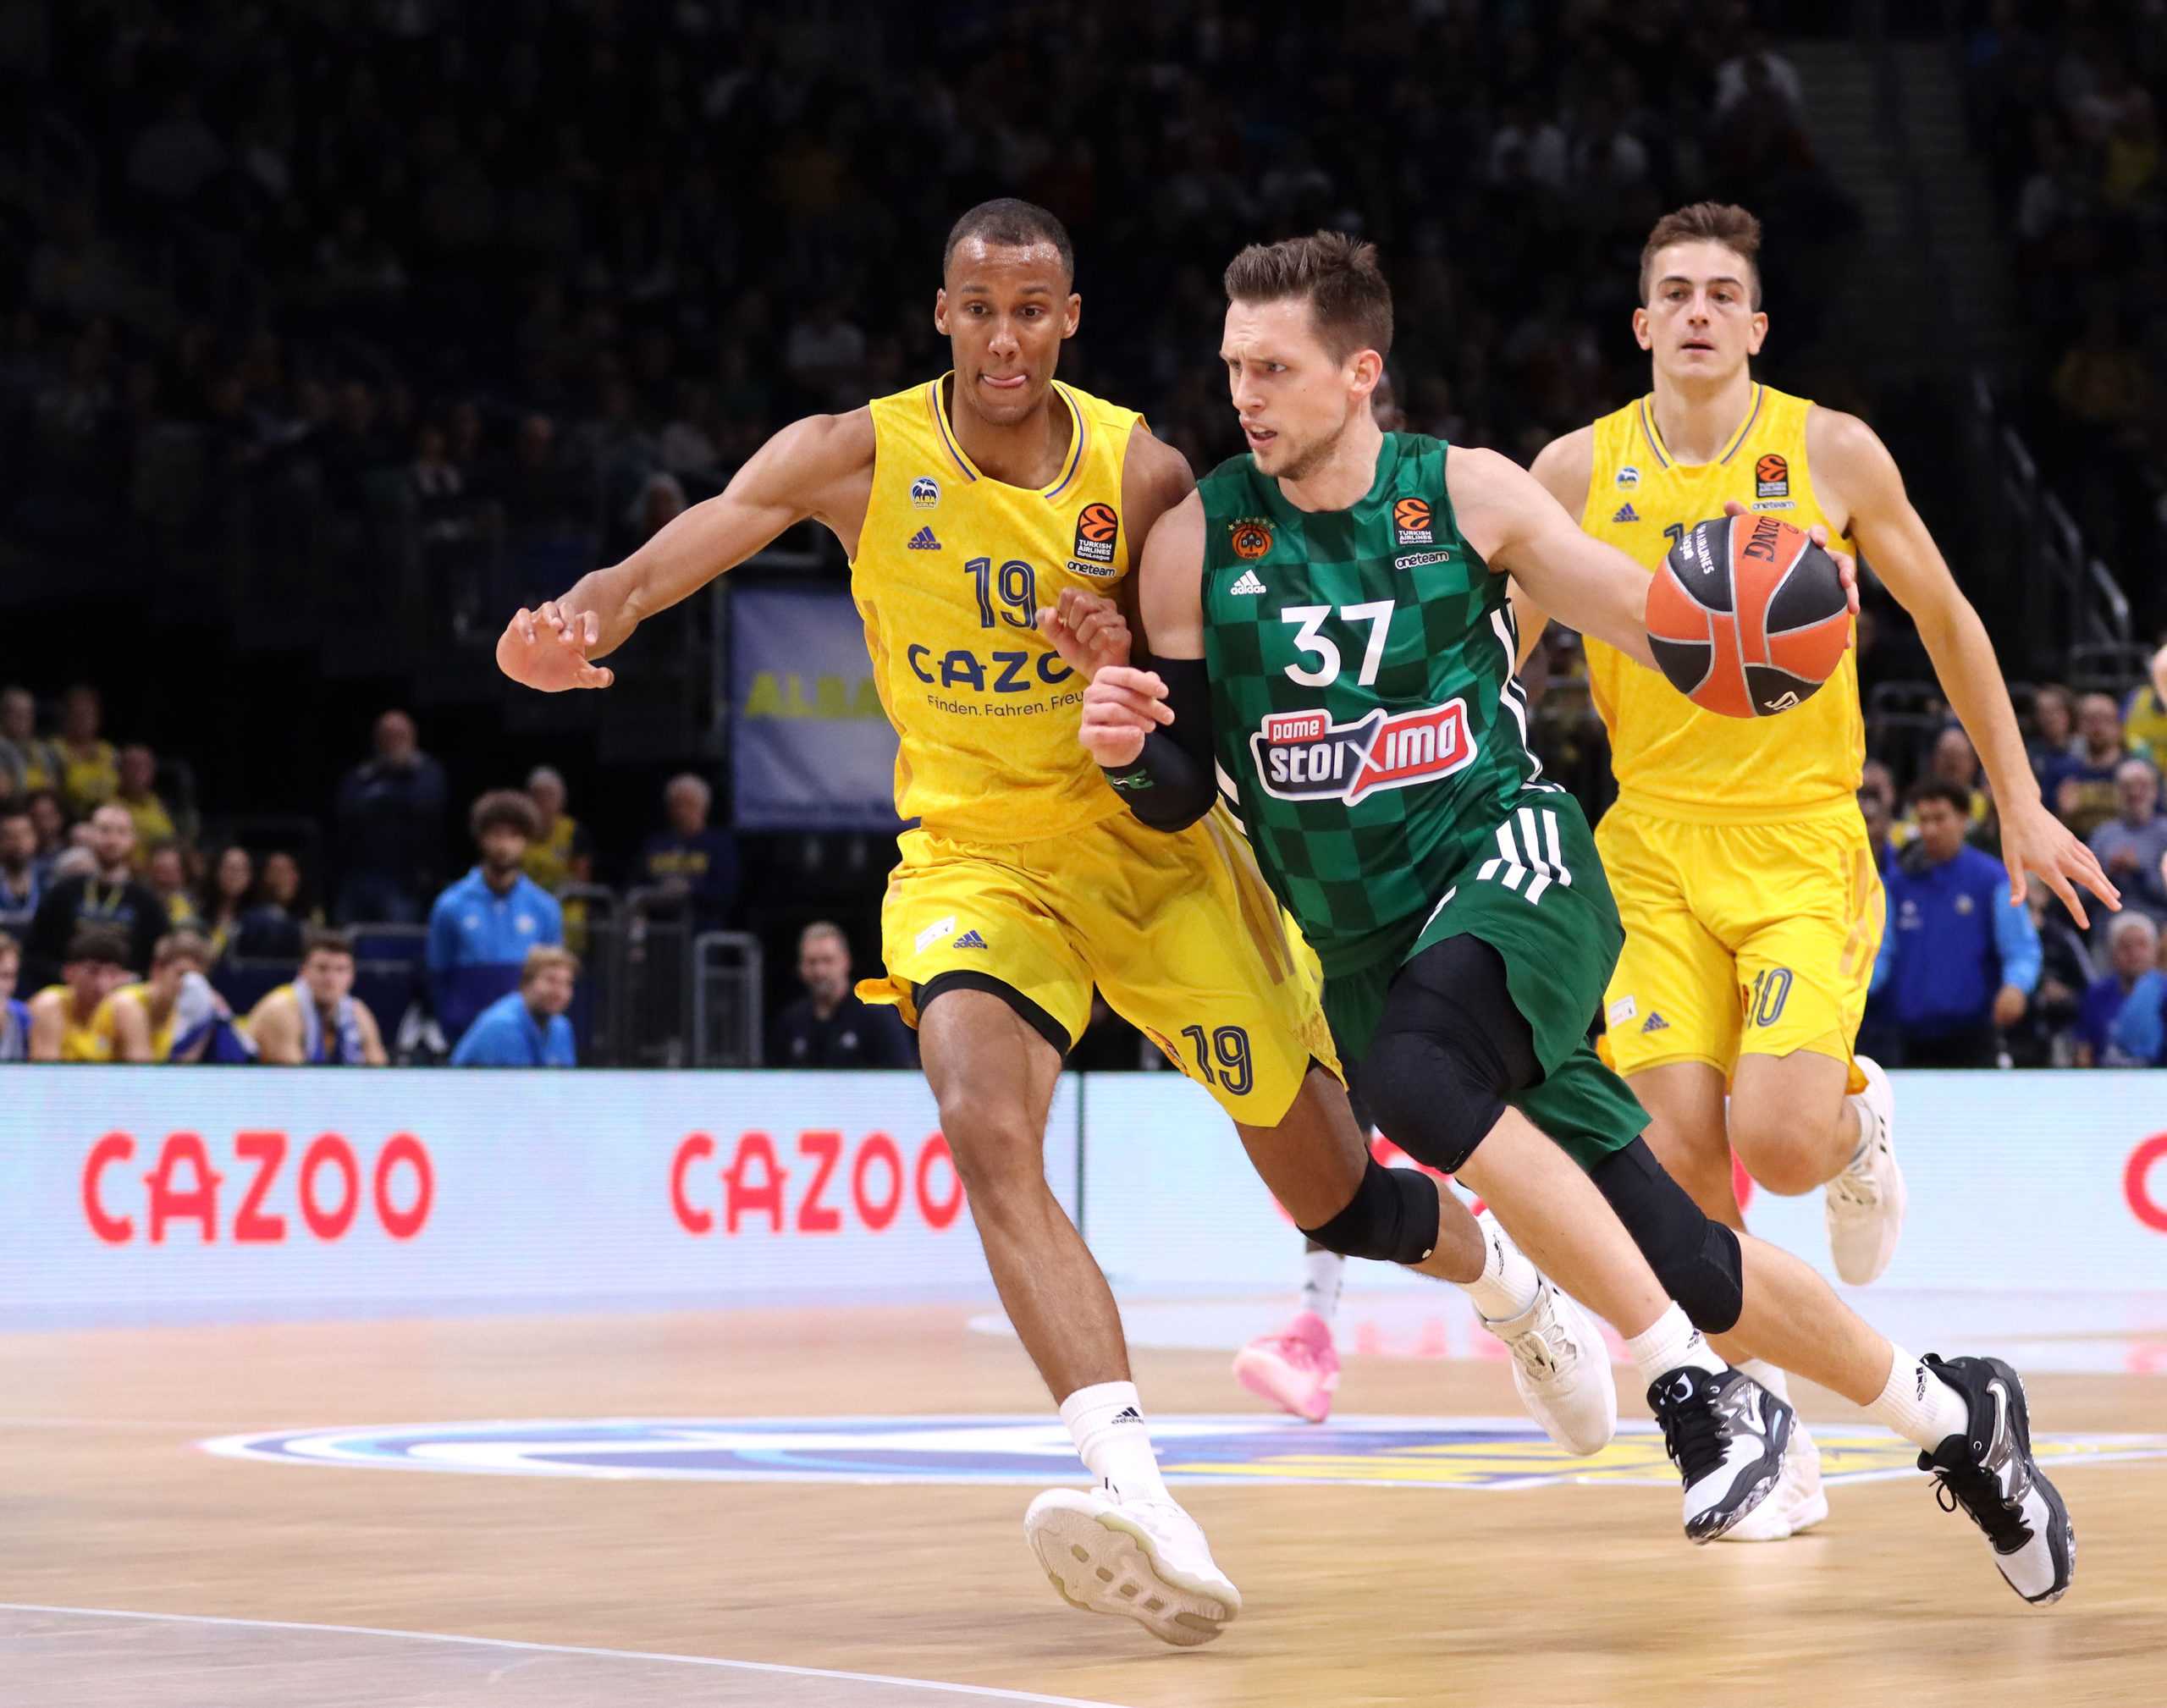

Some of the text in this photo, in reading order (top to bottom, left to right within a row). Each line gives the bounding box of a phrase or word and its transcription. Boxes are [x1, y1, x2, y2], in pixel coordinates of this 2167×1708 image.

[1078, 539, 1112, 550] TURKISH
[1078, 545, 1111, 555] AIRLINES
[1396, 553, 1447, 568] oneteam
[1744, 515, 1782, 563] DING
[1067, 561, 1116, 576] oneteam
[964, 556, 1038, 631] 19
[1281, 599, 1396, 687] 37
[907, 643, 1074, 693] CAZO
[928, 691, 1084, 717] Finden. Fahren. Freu
[1272, 719, 1320, 741] pame
[1181, 1025, 1254, 1095] 19
[81, 1130, 435, 1245] CAZOO
[669, 1130, 966, 1234] CAZOO
